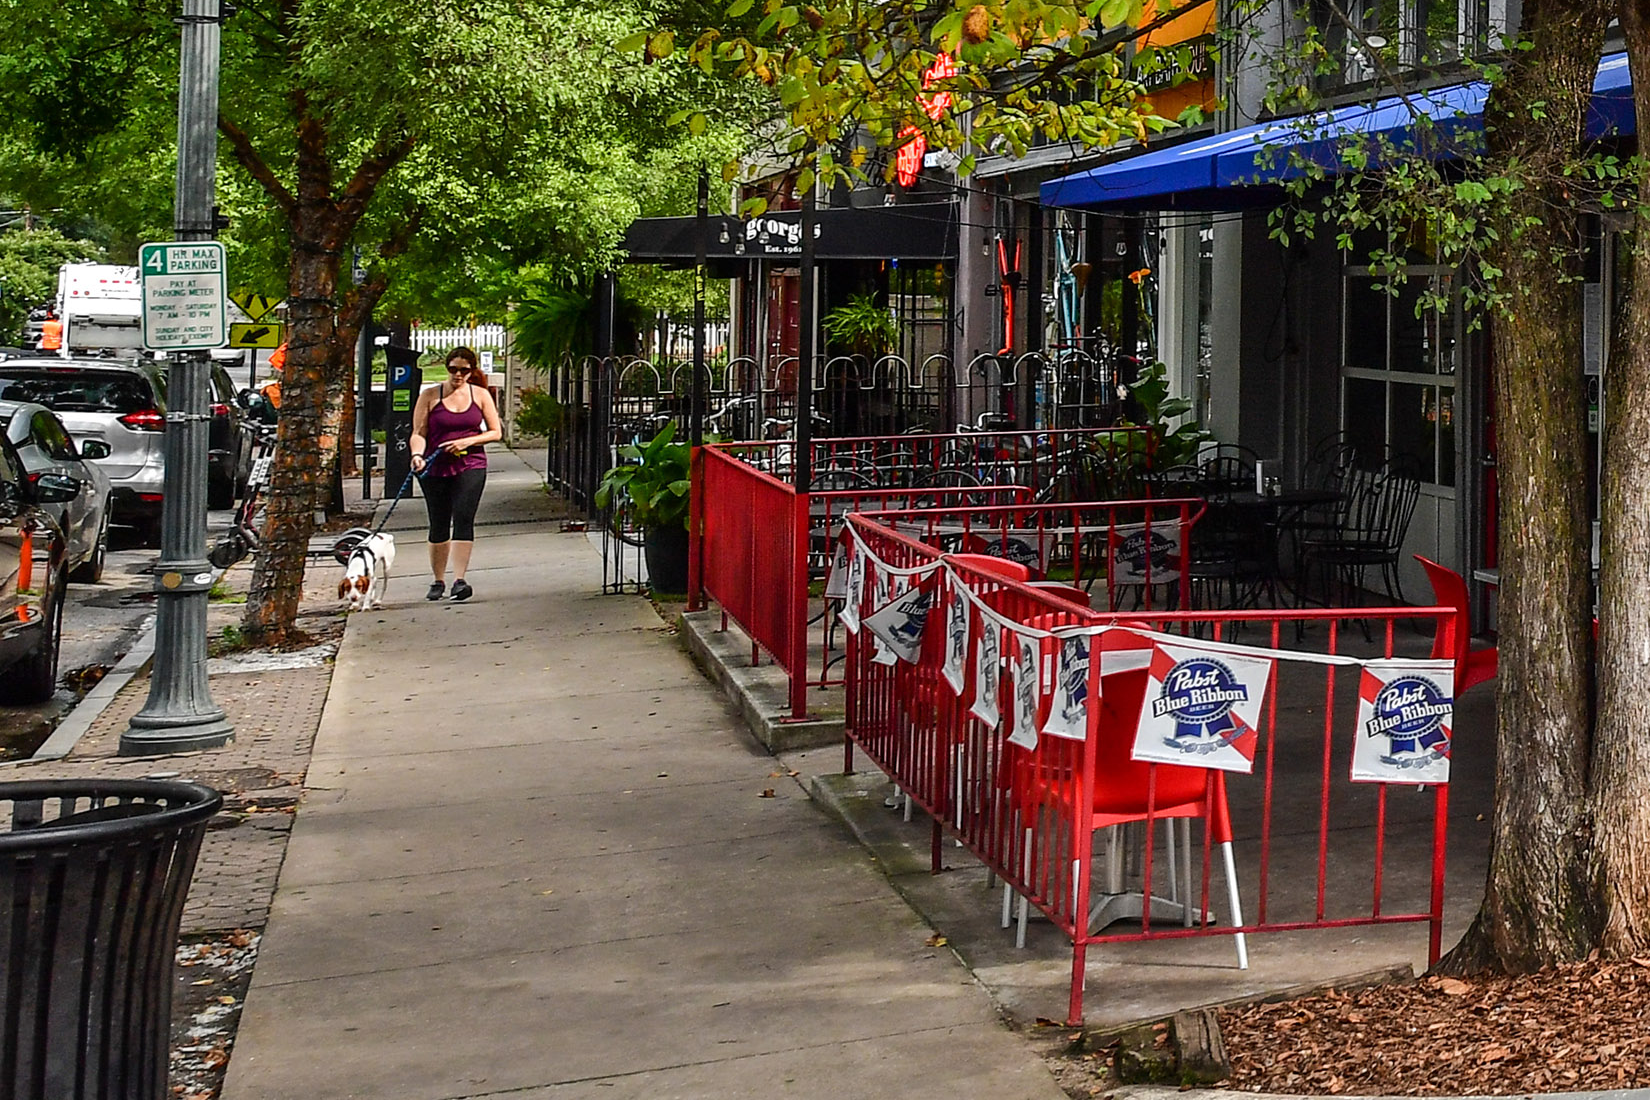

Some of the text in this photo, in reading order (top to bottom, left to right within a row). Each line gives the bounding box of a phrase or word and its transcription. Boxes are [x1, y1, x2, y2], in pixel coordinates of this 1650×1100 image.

[172, 249, 215, 259] HR MAX
[764, 245, 783, 253] Est.
[146, 249, 164, 272] 4
[170, 260, 217, 270] PARKING
[152, 288, 214, 297] PARKING METER
[394, 366, 406, 382] P
[1172, 668, 1220, 693] Pabst
[1154, 685, 1246, 717] Blue Ribbon
[1381, 684, 1426, 712] Pabst
[1189, 704, 1215, 712] BEER
[1368, 701, 1453, 736] Blue Ribbon
[1401, 718, 1425, 729] BEER
